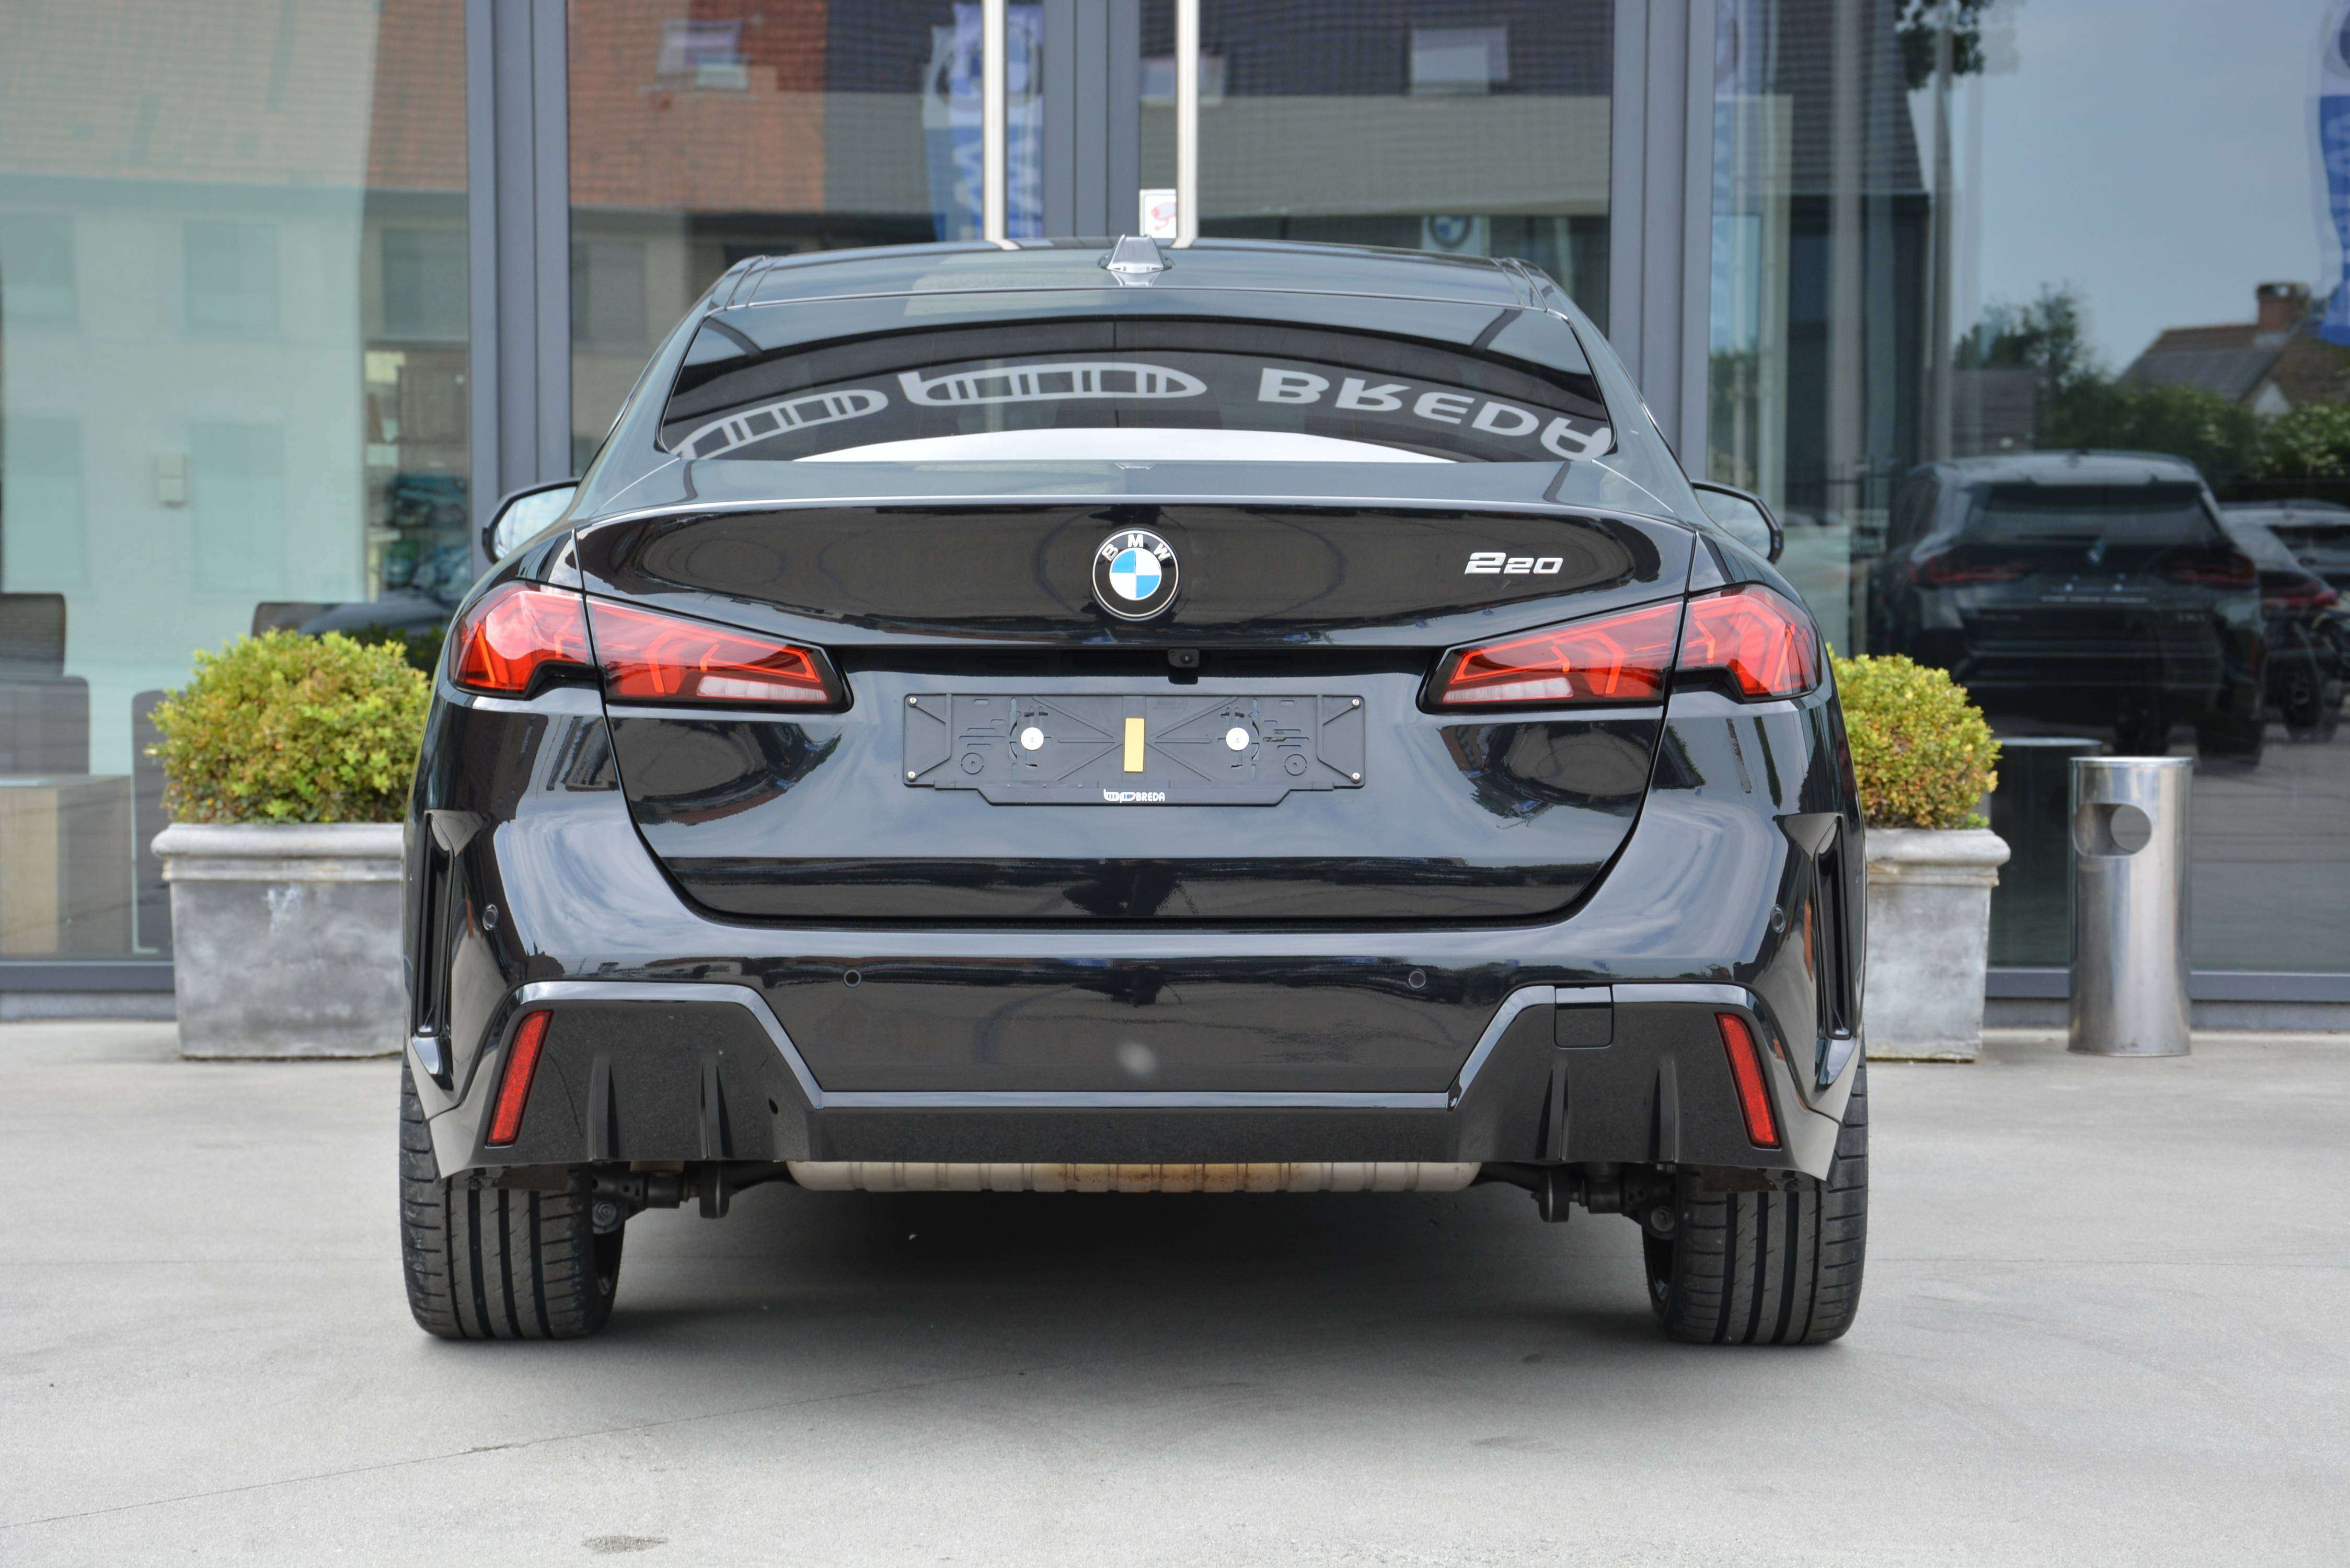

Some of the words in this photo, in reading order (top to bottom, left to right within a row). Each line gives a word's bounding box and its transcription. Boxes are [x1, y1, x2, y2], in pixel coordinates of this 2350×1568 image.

[1101, 534, 1171, 562] BMW
[1464, 552, 1564, 575] 220
[1136, 792, 1165, 802] BREDA
